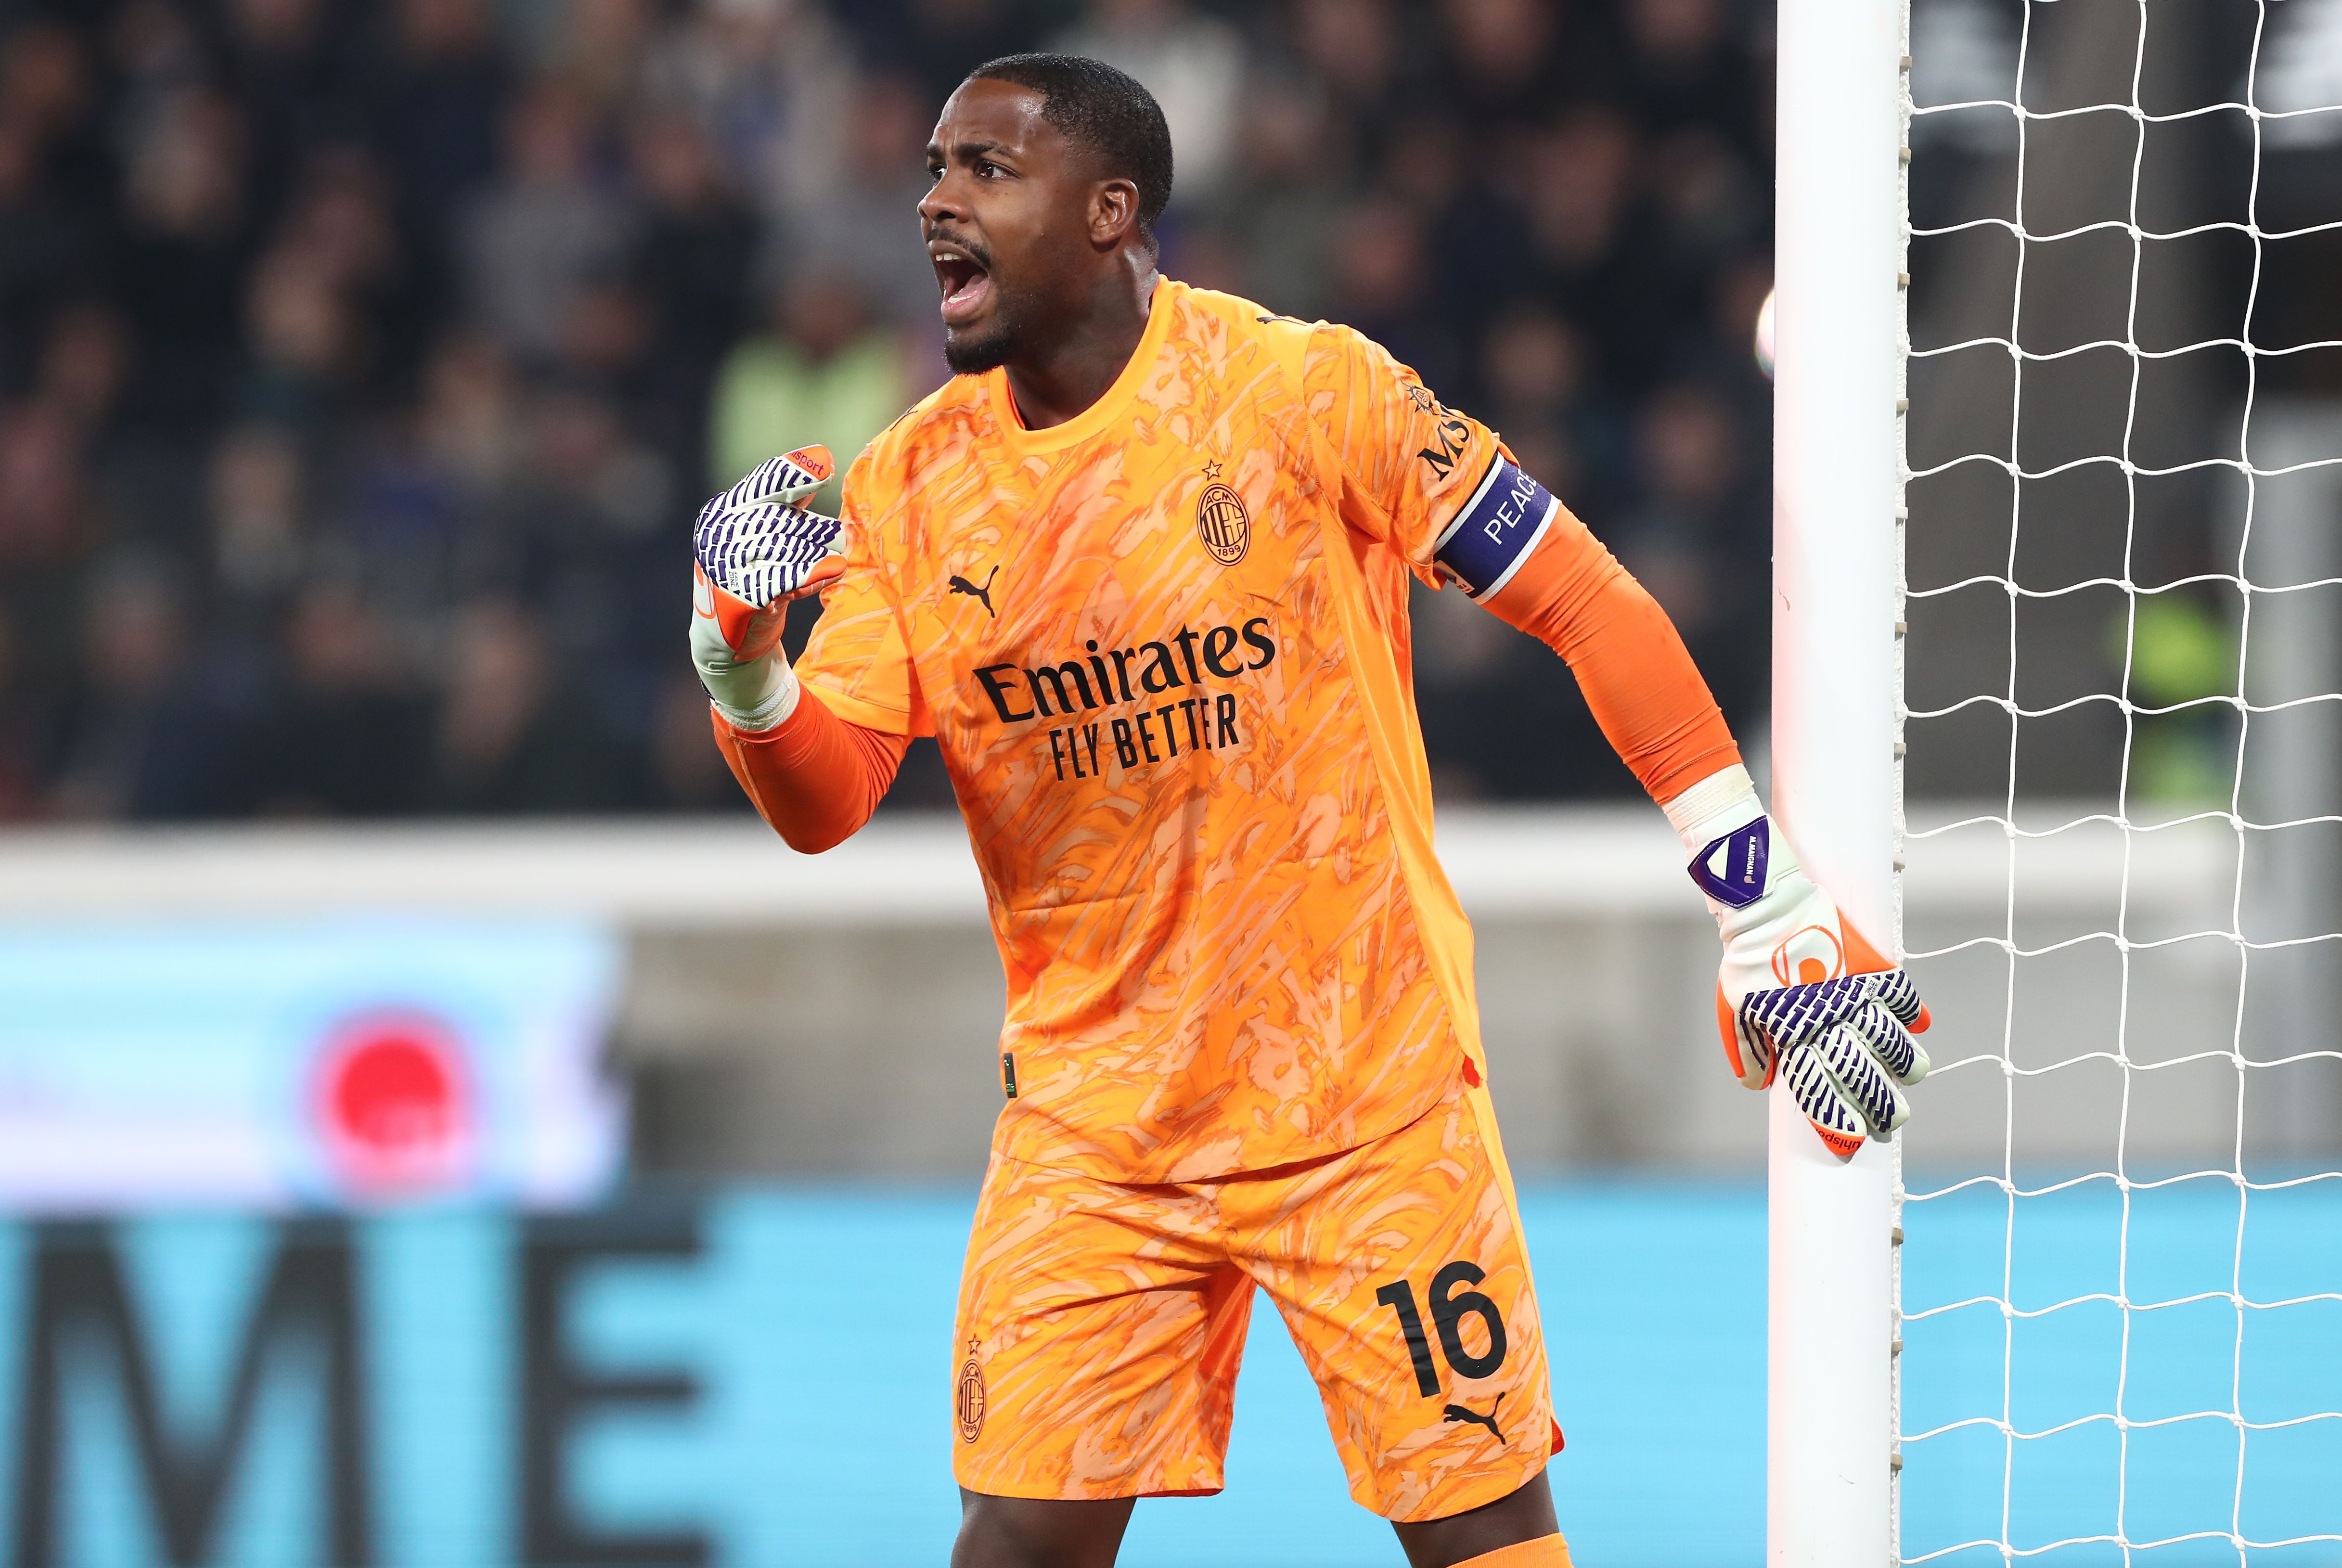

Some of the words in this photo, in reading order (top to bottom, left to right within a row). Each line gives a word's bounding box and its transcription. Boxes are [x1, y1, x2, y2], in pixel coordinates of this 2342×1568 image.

[789, 450, 824, 476] lsport
[1416, 403, 1470, 482] MS
[1205, 491, 1232, 508] ACM
[1486, 468, 1537, 545] PEACE
[1217, 544, 1241, 556] 1899
[972, 617, 1276, 723] Emirates
[1049, 723, 1099, 781] FLY
[1112, 693, 1240, 769] BETTER
[1746, 835, 1756, 875] M.MAIGNAN
[1815, 1129, 1862, 1150] uhlspo
[1376, 1261, 1507, 1398] 16
[10, 1206, 712, 1568] ME
[964, 1424, 977, 1433] 1899
